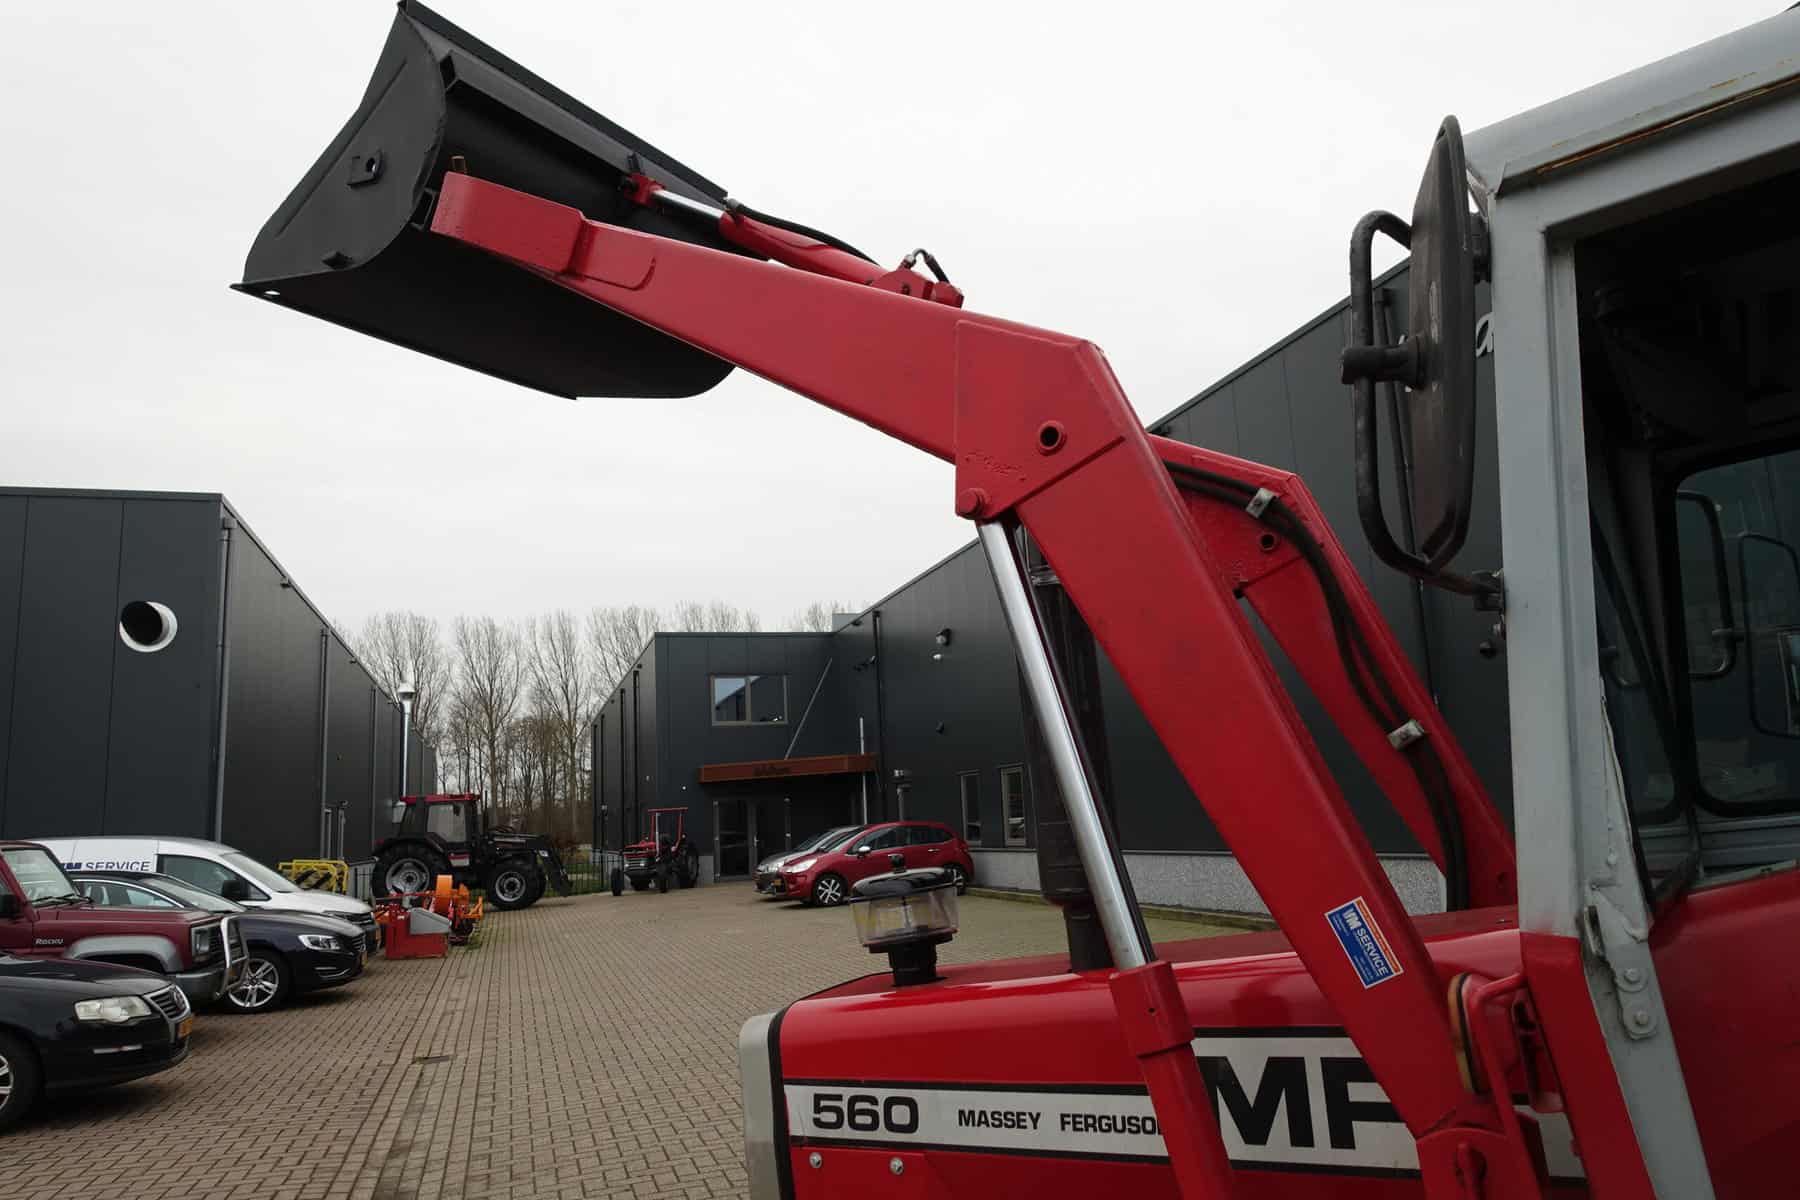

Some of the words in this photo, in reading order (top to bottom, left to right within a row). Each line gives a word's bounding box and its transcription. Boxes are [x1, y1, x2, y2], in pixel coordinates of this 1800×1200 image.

[1357, 928, 1388, 976] SERVICE
[812, 1093, 919, 1134] 560
[958, 1109, 1041, 1130] MASSEY
[1059, 1113, 1162, 1136] FERGUSO
[1195, 1056, 1406, 1150] MF
